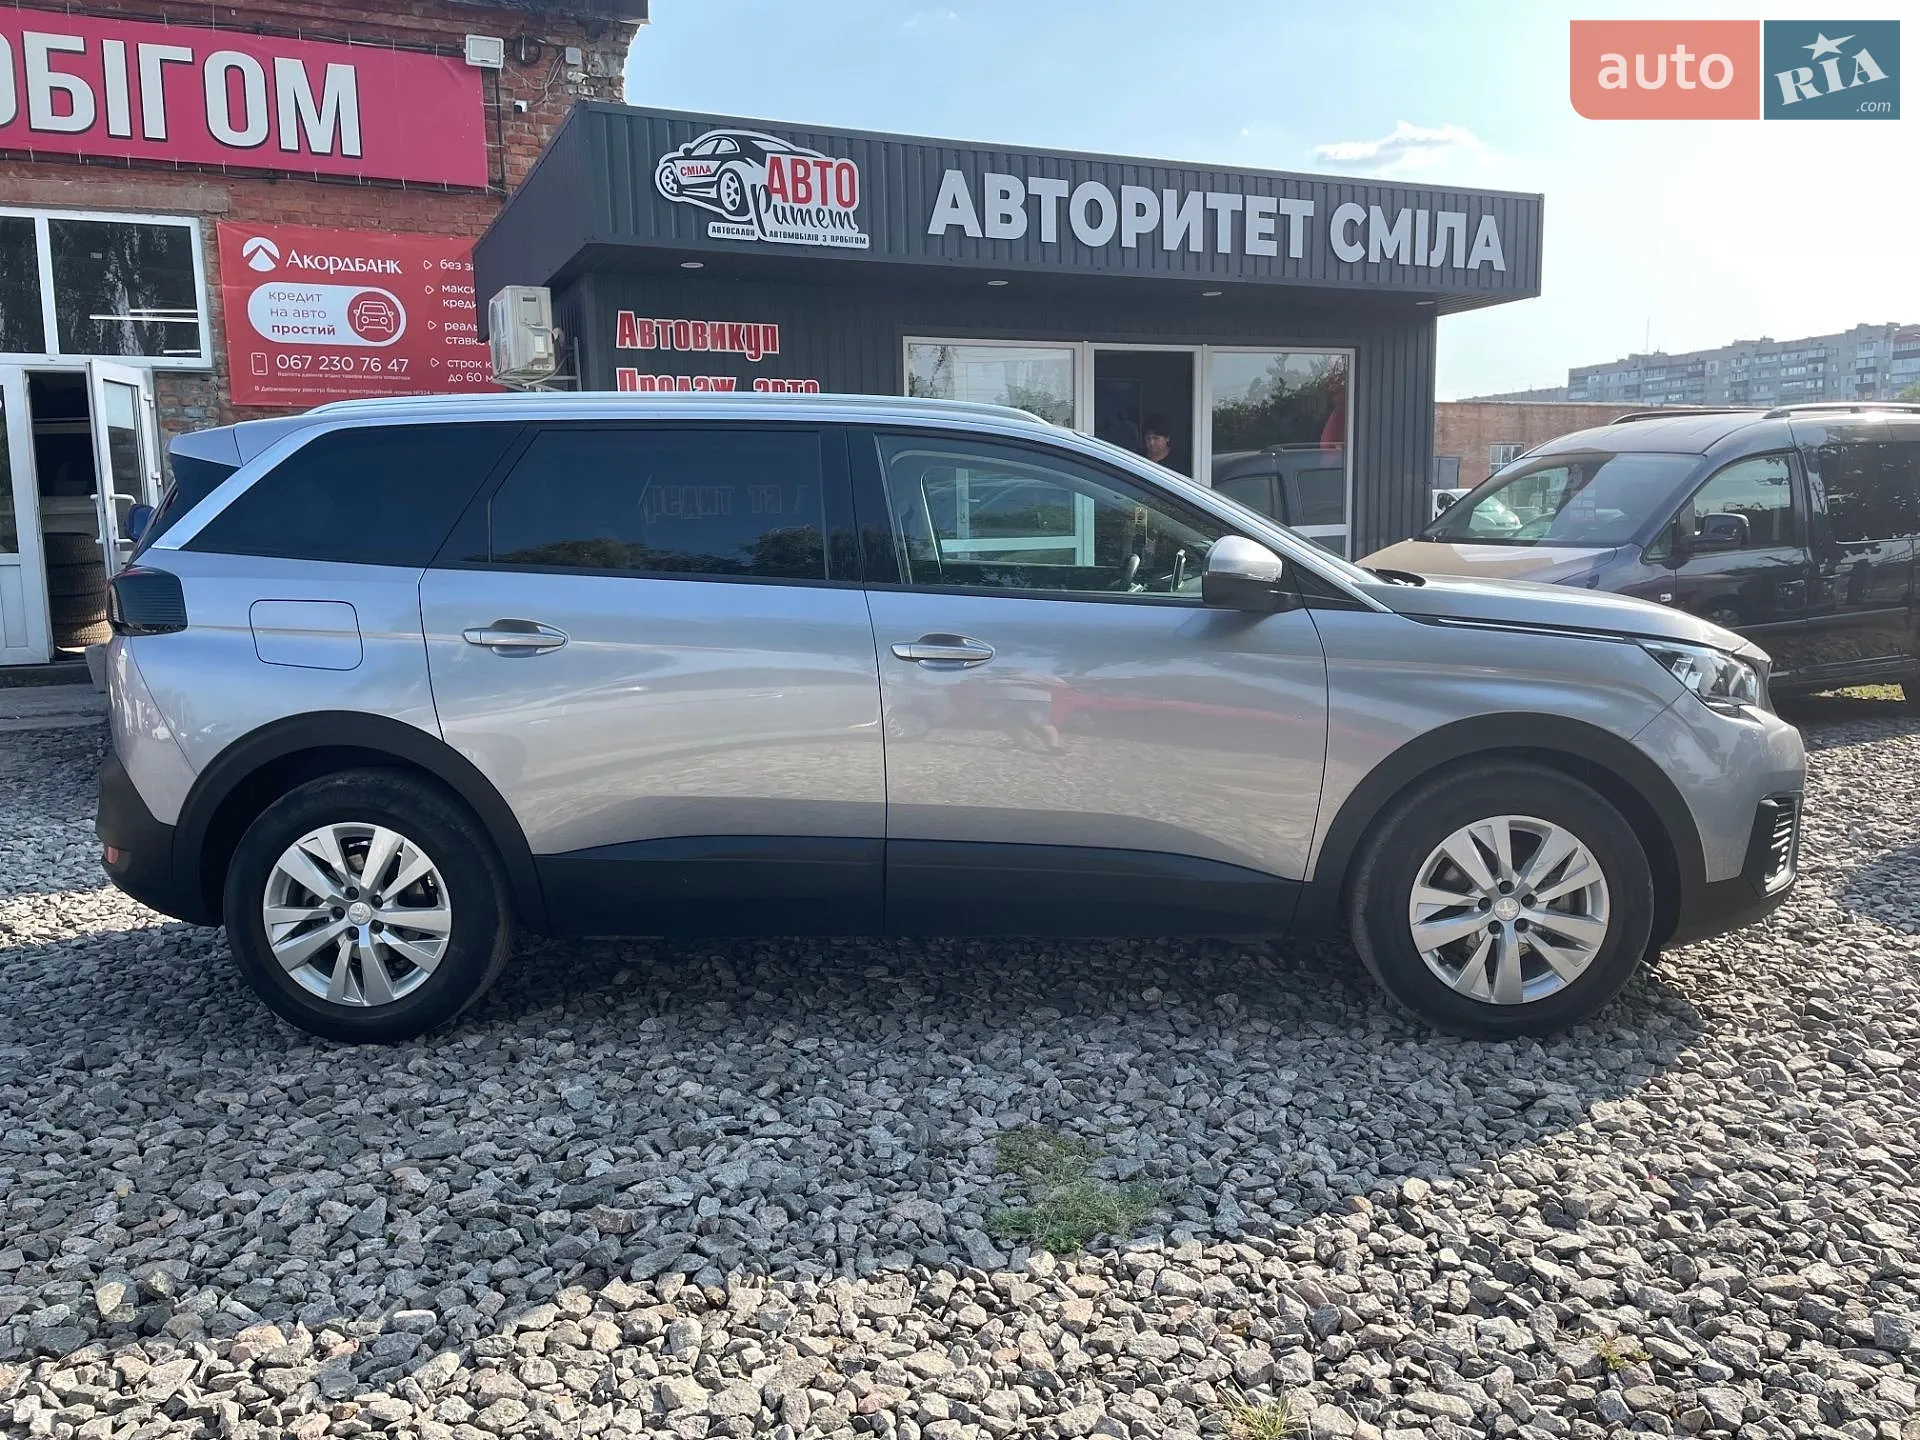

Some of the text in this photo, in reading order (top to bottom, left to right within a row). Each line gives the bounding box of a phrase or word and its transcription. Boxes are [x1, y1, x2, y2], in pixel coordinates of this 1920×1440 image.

[0, 29, 362, 158] БІГОМ
[680, 165, 712, 177] СМІЛА
[767, 155, 857, 209] АВТО
[927, 168, 1507, 272] АВТОРИТЕТ СМІЛА
[711, 225, 755, 237] АВТОСАЛОН
[440, 259, 461, 271] без
[268, 291, 322, 304] кредит
[270, 308, 327, 319] на авто
[271, 323, 336, 336] простий
[616, 310, 779, 361] Автовикуп
[276, 354, 409, 373] 067 230 76 47
[447, 359, 482, 370] строк
[448, 373, 464, 383] до
[466, 372, 482, 382] 60
